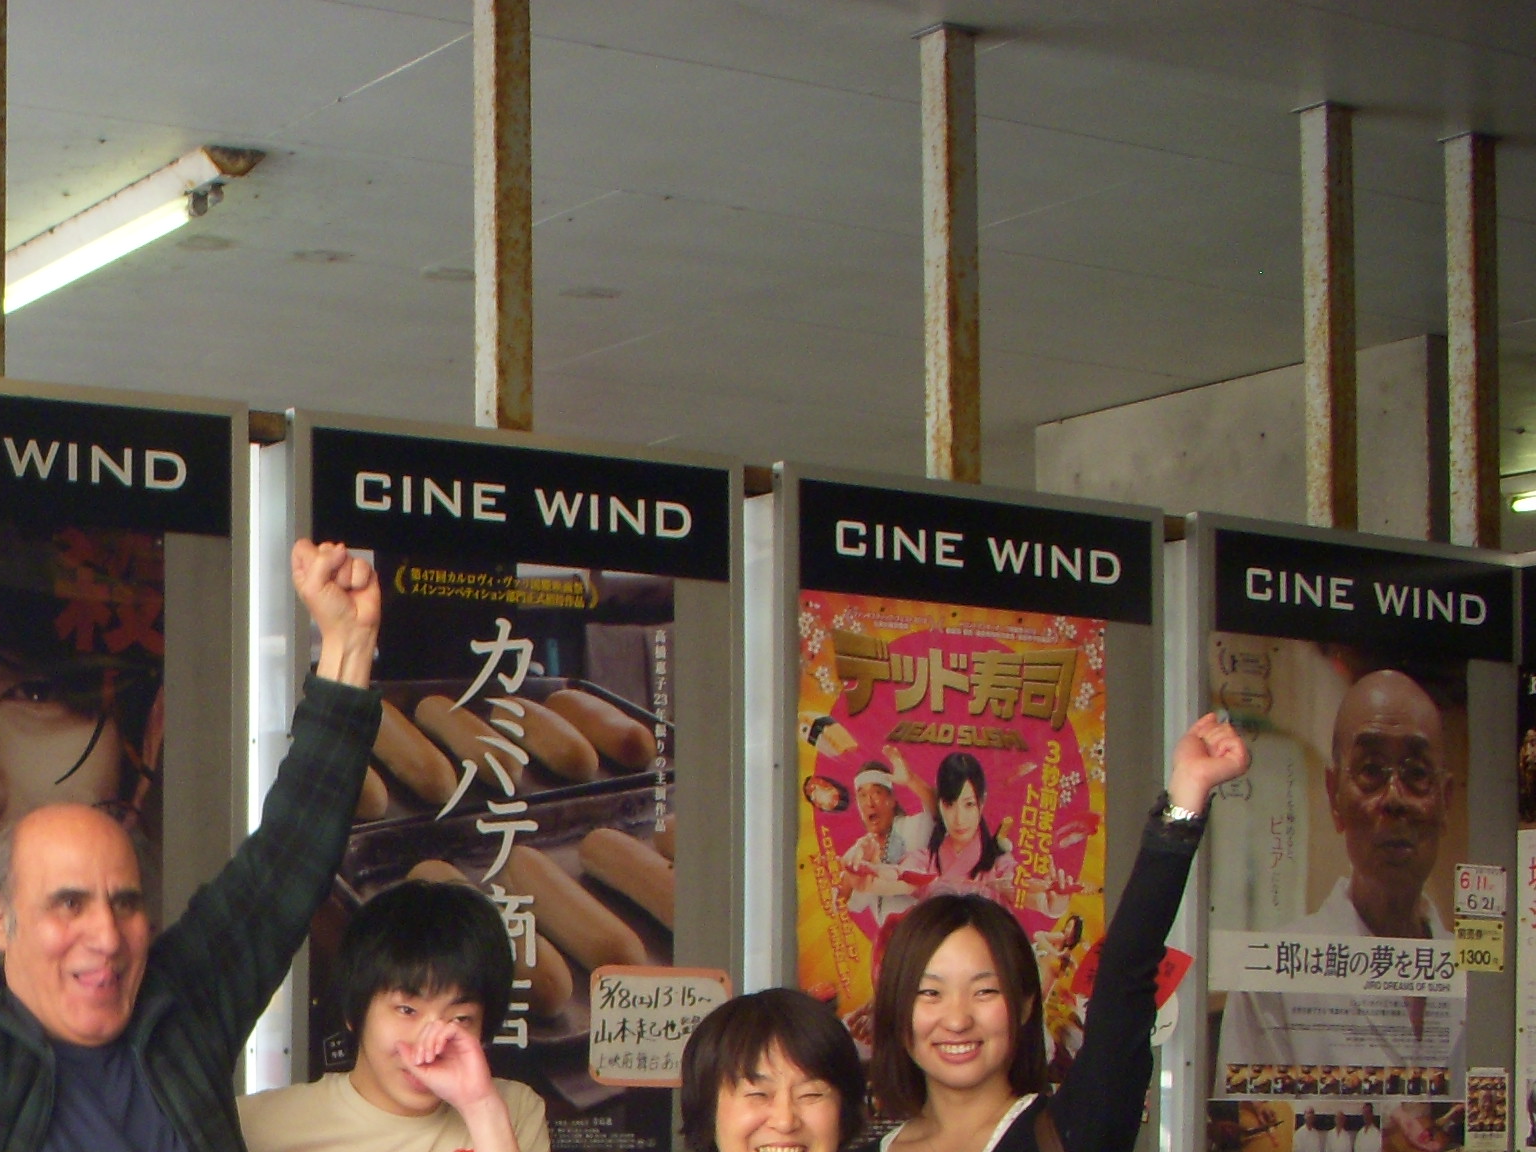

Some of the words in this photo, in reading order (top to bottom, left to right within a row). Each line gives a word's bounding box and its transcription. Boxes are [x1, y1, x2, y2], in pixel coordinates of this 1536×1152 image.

[3, 437, 188, 492] WIND
[354, 470, 507, 523] CINE
[535, 487, 693, 540] WIND
[835, 519, 965, 569] CINE
[987, 537, 1121, 586] WIND
[1245, 566, 1355, 611] CINE
[1372, 581, 1487, 627] WIND
[833, 629, 1078, 732] デッド寿司
[1244, 940, 1456, 980] 二郎は鮨の夢を見る
